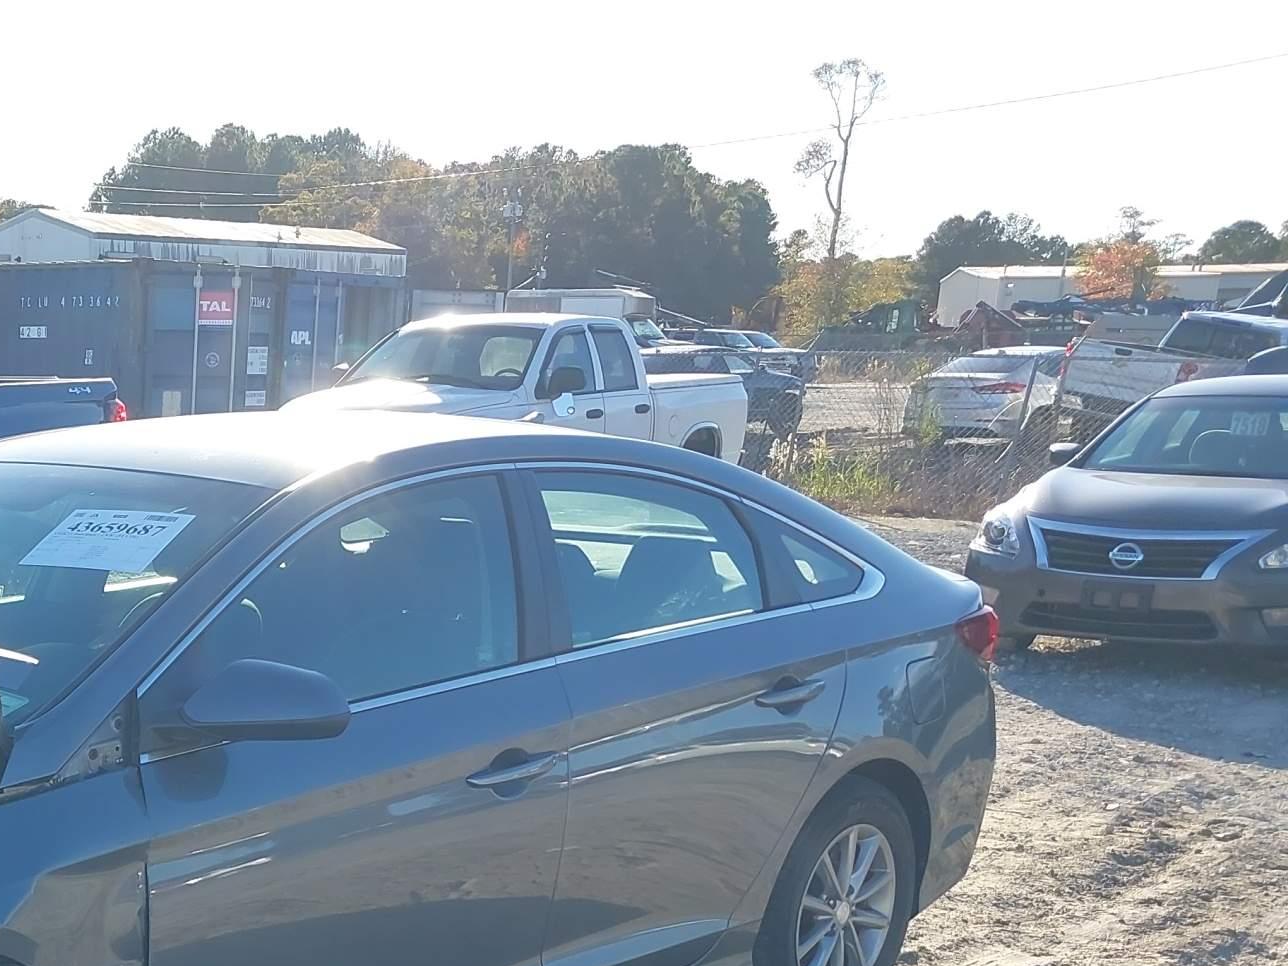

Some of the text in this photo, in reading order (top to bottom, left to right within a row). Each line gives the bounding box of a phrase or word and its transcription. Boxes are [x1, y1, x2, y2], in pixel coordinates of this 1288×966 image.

[199, 300, 231, 312] TAL
[290, 330, 311, 345] APL
[67, 521, 169, 537] 43659687
